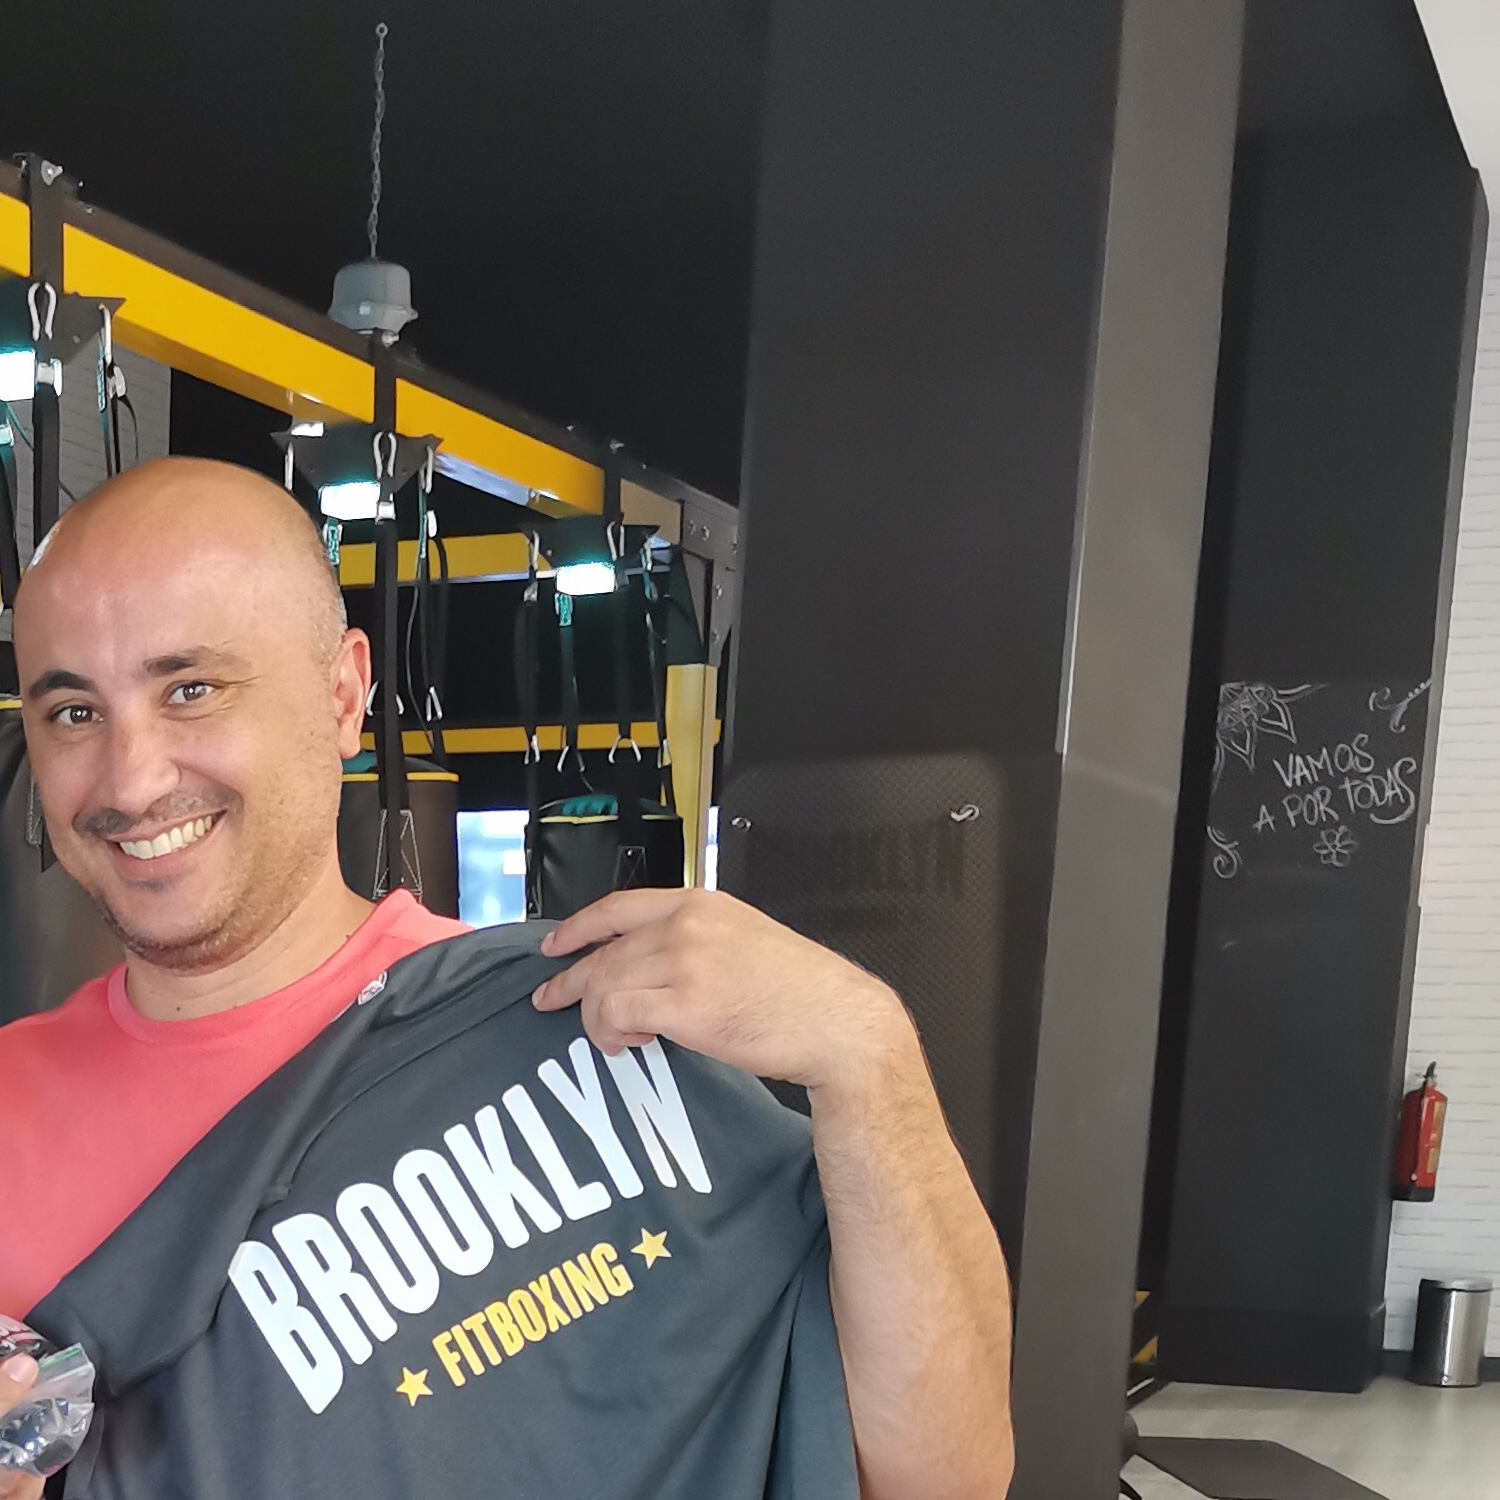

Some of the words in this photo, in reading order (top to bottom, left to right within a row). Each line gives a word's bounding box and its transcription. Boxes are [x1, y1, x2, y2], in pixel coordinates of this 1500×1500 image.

[1252, 804, 1277, 832] A
[1282, 786, 1339, 828] POR
[1338, 757, 1417, 825] TODAS
[1273, 733, 1374, 788] VAMOS
[228, 1036, 713, 1414] BROOKLYN
[432, 1242, 634, 1387] FITBOXING
